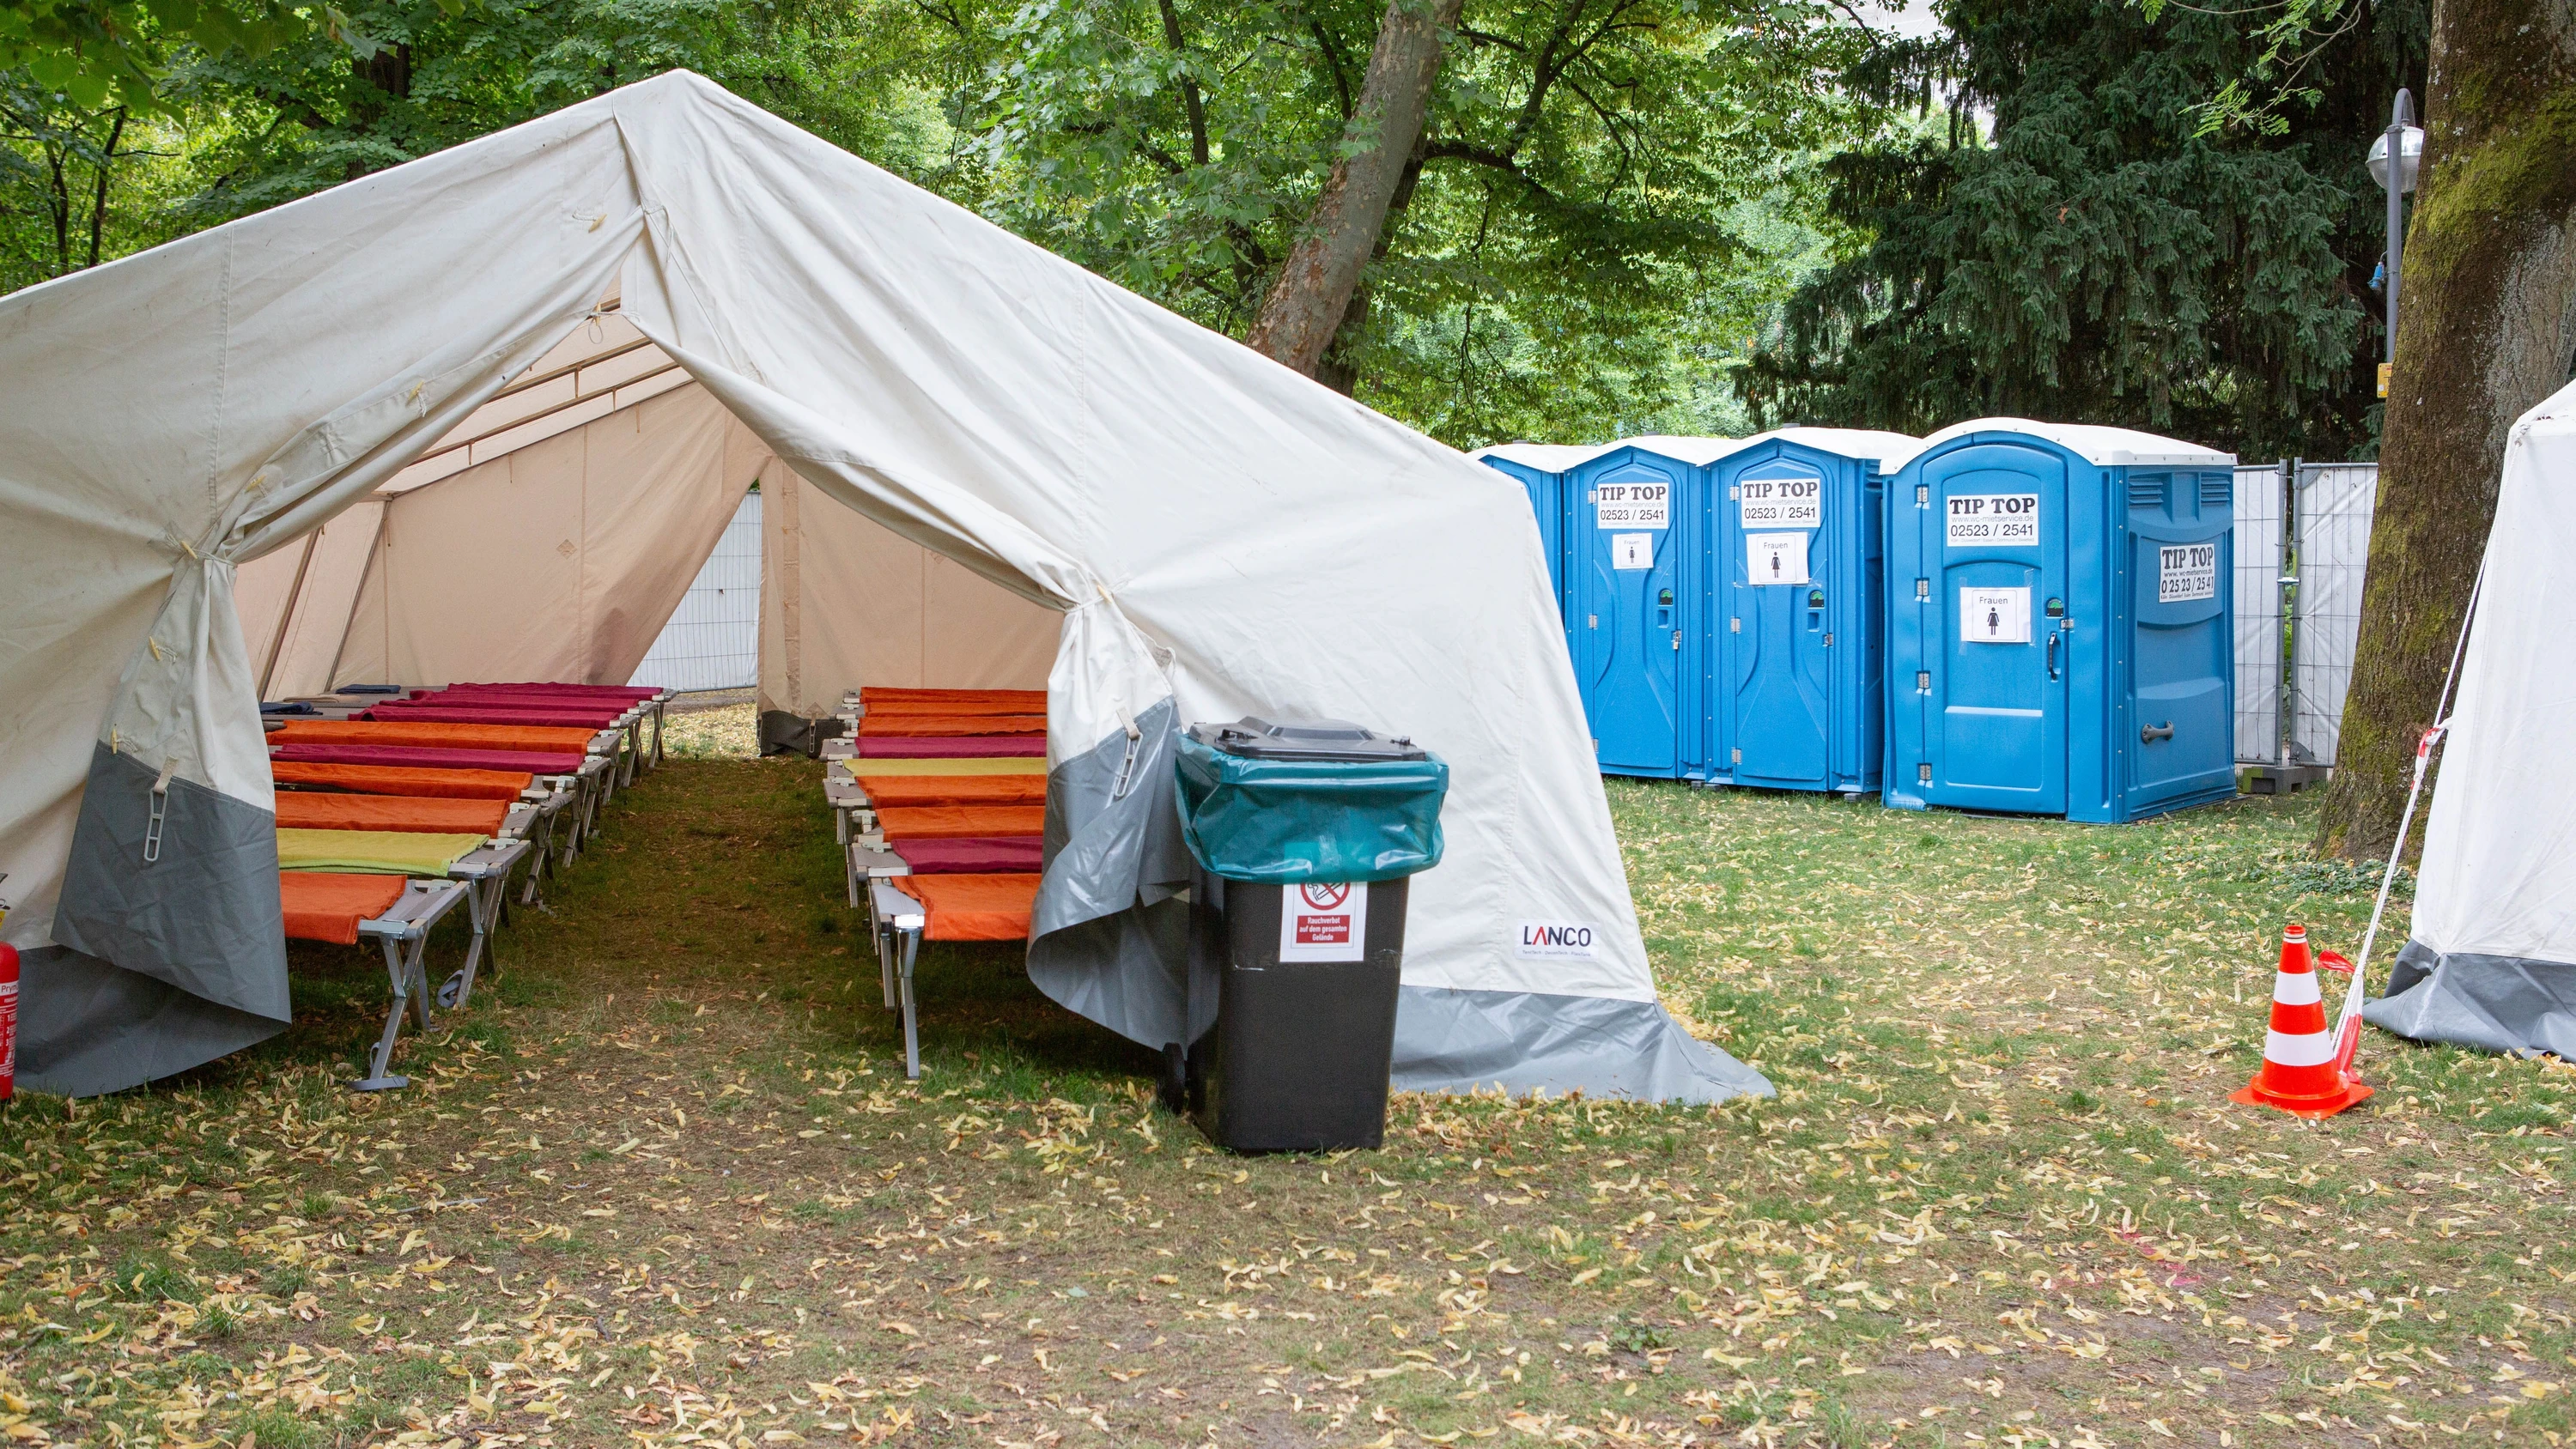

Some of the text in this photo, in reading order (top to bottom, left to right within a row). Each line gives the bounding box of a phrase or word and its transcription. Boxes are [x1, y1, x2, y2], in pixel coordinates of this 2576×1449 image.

[1600, 486, 1666, 500] TIP TOP
[1743, 482, 1818, 498] TIP TOP
[1745, 507, 1777, 519] 02523
[1789, 506, 1815, 518] 2541
[1949, 498, 2035, 514] TIP TOP
[1601, 510, 1629, 520] 02523
[1640, 510, 1664, 520] 2541
[1951, 524, 1989, 537] 02523
[2002, 524, 2032, 536] 2541
[2162, 547, 2213, 569] TIP TOP
[1321, 925, 1347, 934] gesamten
[1523, 925, 1591, 947] LANCO
